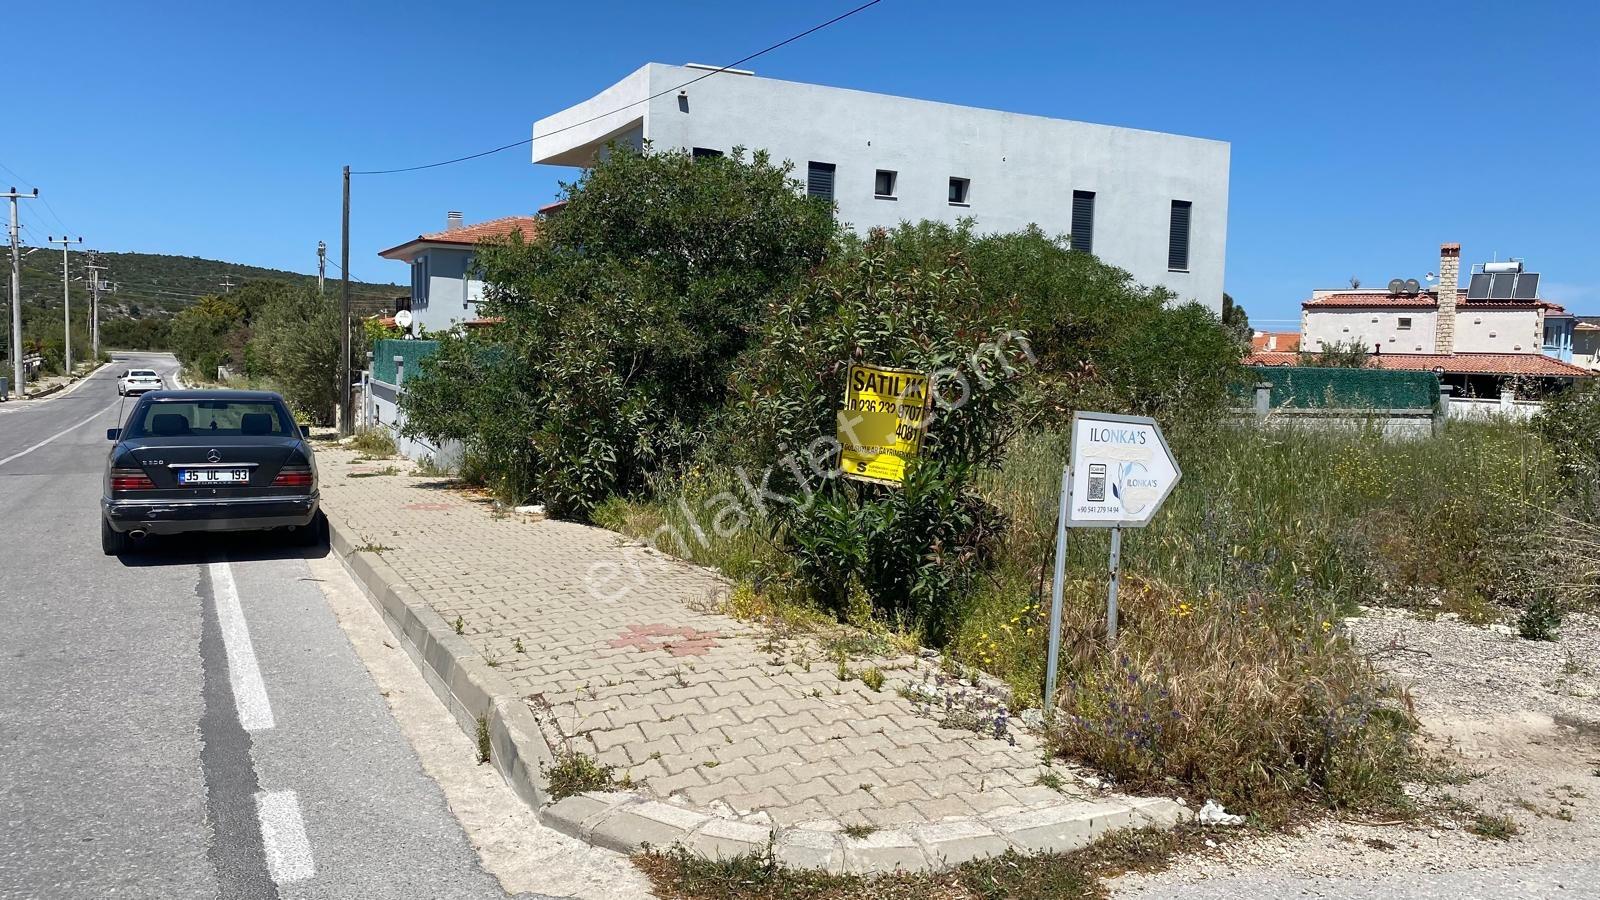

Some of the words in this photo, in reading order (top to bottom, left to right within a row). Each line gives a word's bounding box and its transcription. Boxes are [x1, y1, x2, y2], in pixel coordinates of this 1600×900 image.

[853, 370, 924, 399] SATILIK
[858, 399, 877, 413] 236
[878, 401, 896, 414] 232
[895, 423, 919, 442] 4081
[1090, 428, 1147, 445] ILONKA'S
[856, 461, 867, 473] S
[186, 470, 199, 481] 35
[207, 470, 220, 481] UC
[231, 469, 248, 480] 193
[1127, 479, 1158, 488] ILONKA'S
